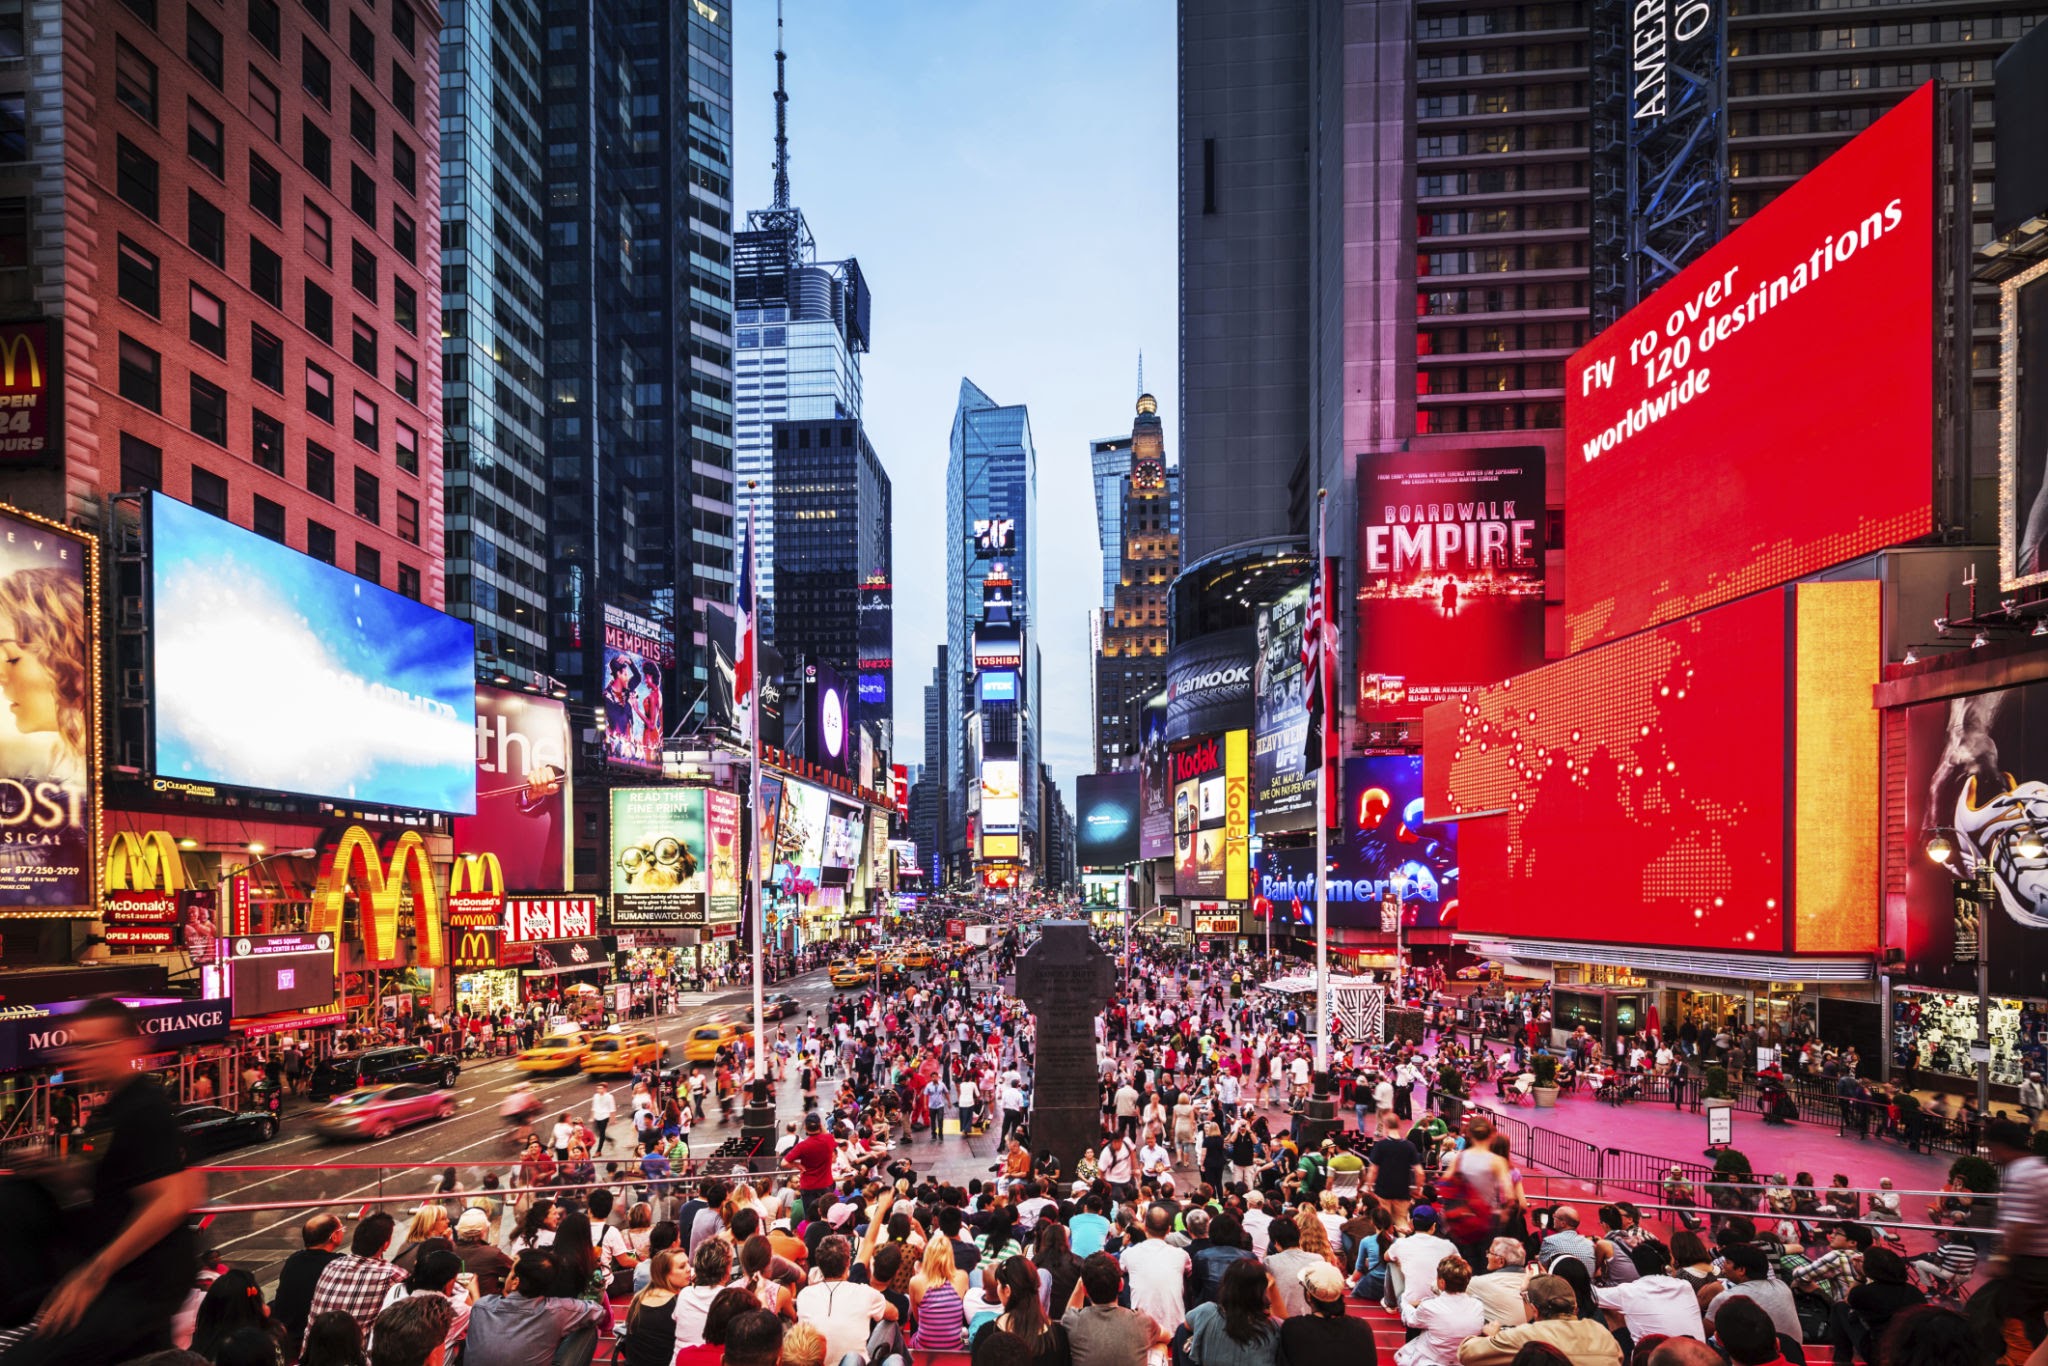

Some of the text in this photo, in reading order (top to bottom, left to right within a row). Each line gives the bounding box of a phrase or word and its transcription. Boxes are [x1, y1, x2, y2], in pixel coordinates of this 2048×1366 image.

[1644, 198, 1903, 388] 120 destinations
[1583, 266, 1739, 397] Fly to over
[1583, 368, 1711, 463] worldwide
[1384, 501, 1517, 524] BOARDWALK
[1366, 520, 1536, 573] EMPIRE
[604, 612, 661, 641] BEST MUSICAL
[605, 626, 661, 661] MEMPHIS
[975, 656, 1020, 665] TOSHIBA
[1184, 682, 1250, 701] driving emotion
[1408, 686, 1430, 694] SEASON
[1443, 685, 1471, 693] AVAILABLE
[1177, 738, 1219, 781] Kodak
[1276, 744, 1299, 769] UFC
[1283, 773, 1295, 785] MAY
[1296, 770, 1304, 782] 26
[630, 792, 687, 802] READ THE
[627, 803, 689, 814] FINE PRINT
[1227, 776, 1246, 857] Kodak
[15, 865, 80, 875] 877-250-2929
[1262, 873, 1297, 901] Bank
[1297, 872, 1315, 901] of
[103, 899, 175, 912] McDonald's
[449, 898, 500, 906] McDonald's
[115, 912, 163, 920] Restaurant
[617, 912, 703, 920] HUMANEWATCH.ORG
[1212, 920, 1238, 932] EVITA
[106, 932, 170, 940] OPEN 24 HOURS
